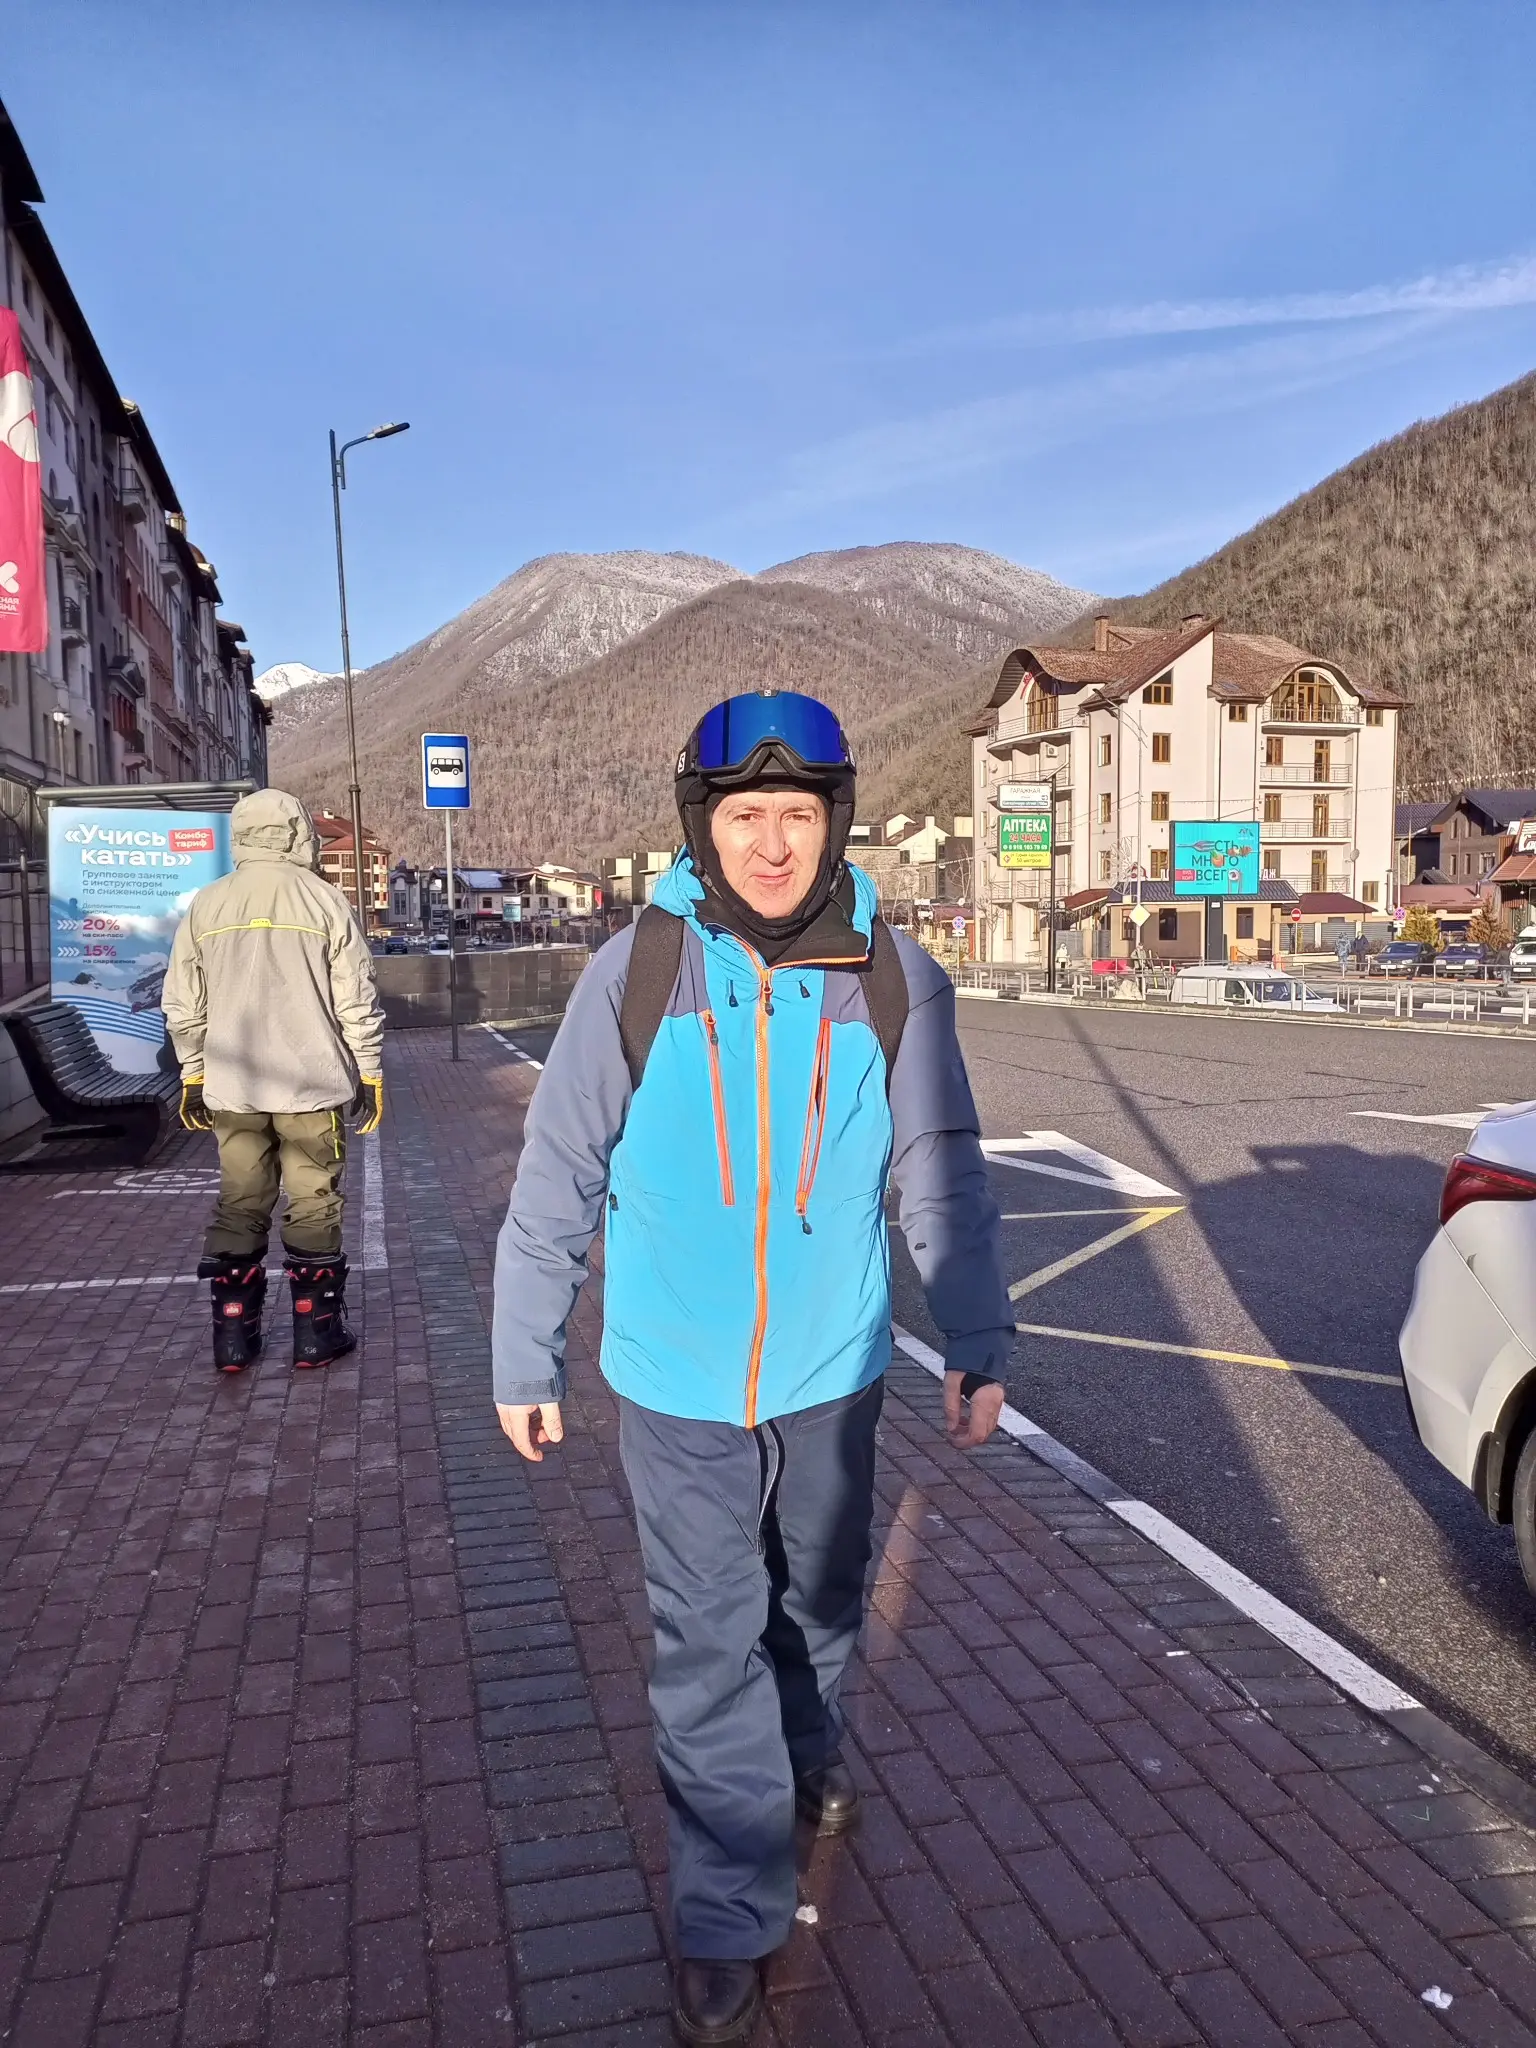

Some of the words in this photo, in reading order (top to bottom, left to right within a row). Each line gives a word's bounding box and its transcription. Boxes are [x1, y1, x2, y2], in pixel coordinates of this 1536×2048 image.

[1003, 818, 1048, 833] АПТЕКА
[64, 823, 167, 847] «Учись
[174, 831, 210, 841] Комбо-
[1009, 833, 1019, 843] 24
[1020, 833, 1042, 843] ЧАСА
[175, 840, 209, 849] тариф
[81, 849, 193, 868] катать»
[1191, 854, 1239, 867] МНГО
[82, 870, 136, 883] Групповое
[138, 872, 179, 880] занятие
[1196, 869, 1240, 881] ВСЕГ
[90, 880, 163, 889] инструктором
[97, 888, 155, 896] сниженной
[156, 889, 181, 898] цене
[83, 919, 120, 930] 20%
[84, 945, 117, 957] 15%
